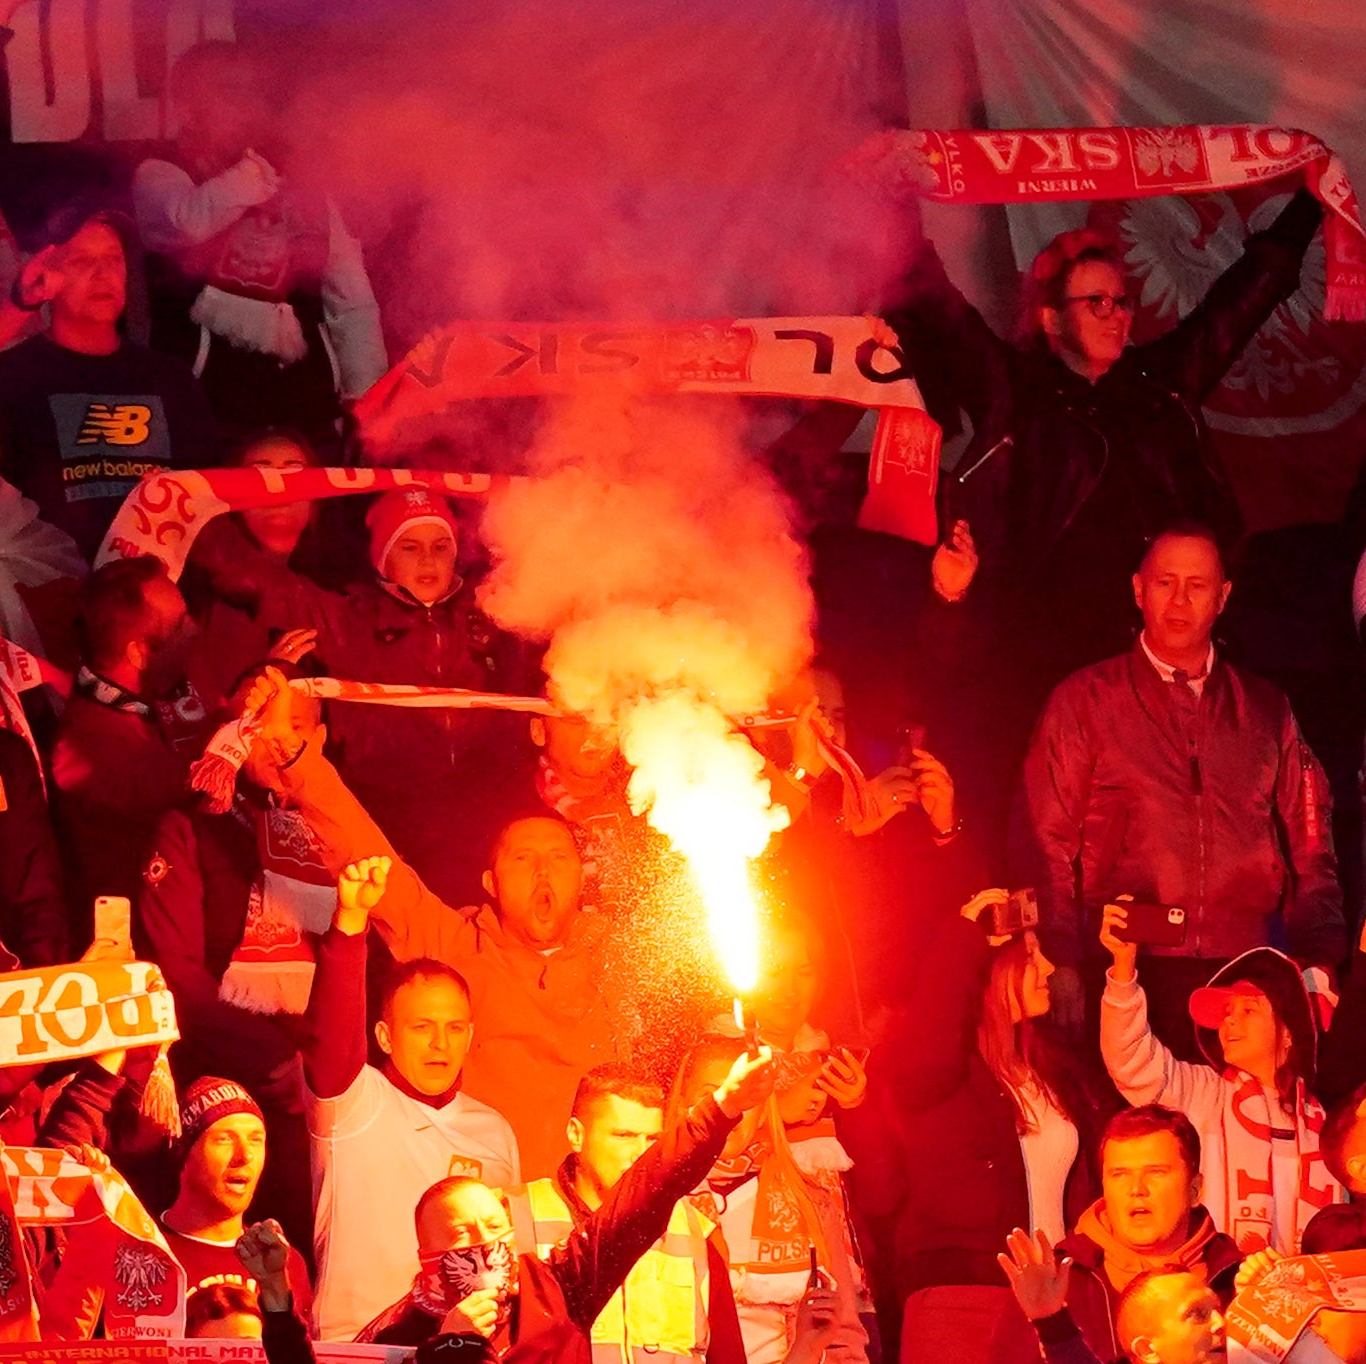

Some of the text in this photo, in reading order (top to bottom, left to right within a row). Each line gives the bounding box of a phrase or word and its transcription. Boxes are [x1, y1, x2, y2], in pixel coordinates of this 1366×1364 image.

[974, 134, 1120, 175] SKA
[1019, 181, 1097, 194] WIERNI
[62, 460, 106, 482] new
[26, 1345, 265, 1361] INTERNATIONAL MAT
